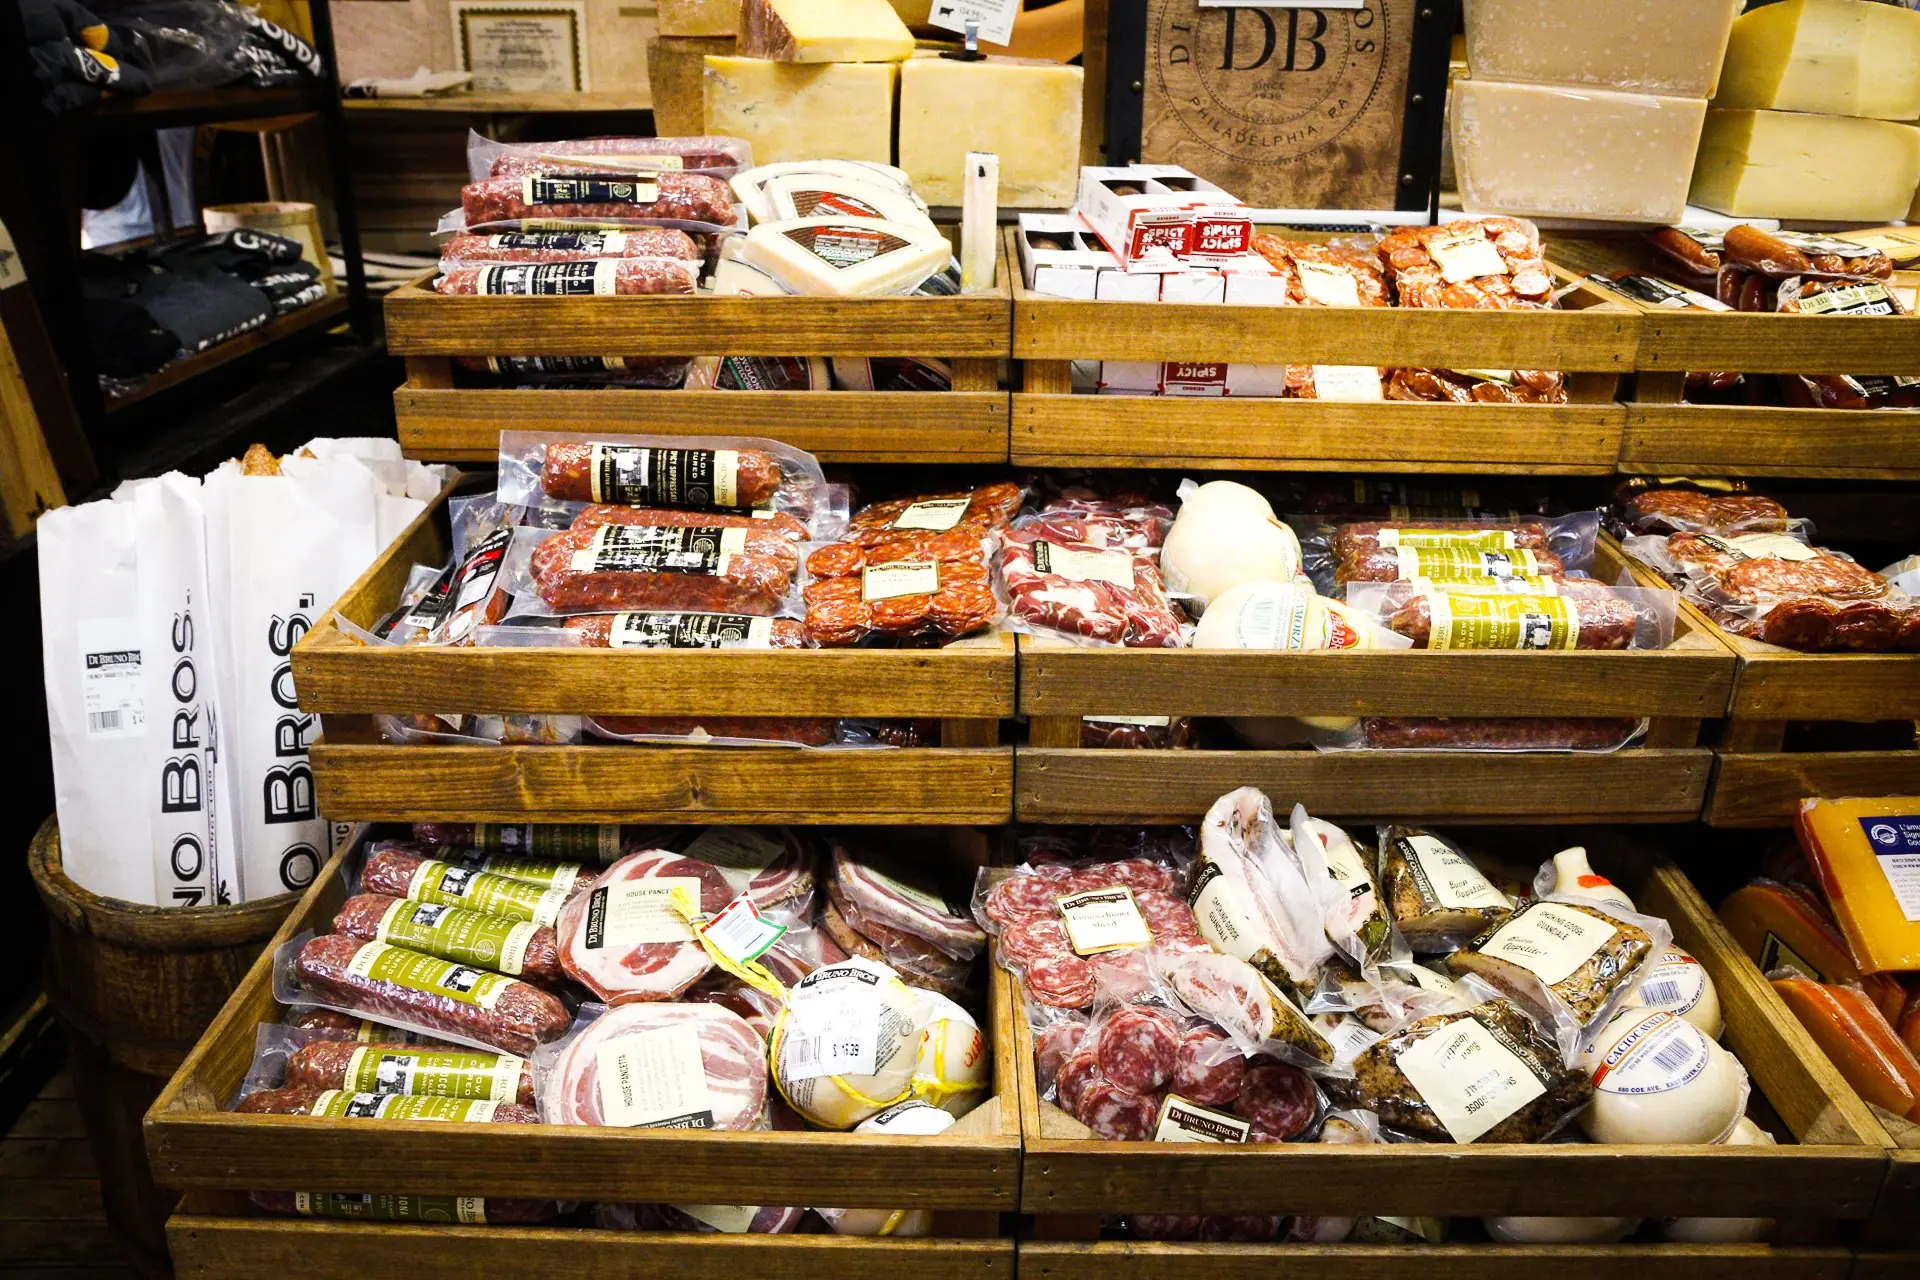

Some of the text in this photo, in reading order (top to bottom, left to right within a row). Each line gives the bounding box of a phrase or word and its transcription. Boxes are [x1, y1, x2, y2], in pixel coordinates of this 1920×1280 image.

[1169, 24, 1191, 66] DI
[1216, 7, 1328, 72] DB
[1189, 95, 1348, 147] PHILADELPHIA PA
[1202, 224, 1243, 236] SPICY
[1176, 366, 1217, 377] SPICY
[669, 466, 678, 503] SOPPRESSAT
[1409, 860, 1431, 892] BRUNO
[625, 888, 672, 898] HOUSE PANCE
[1425, 895, 1435, 904] DI
[1212, 896, 1229, 923] SMOKING
[589, 910, 600, 935] BRUNO
[1208, 911, 1228, 944] GUANCIALE
[1536, 920, 1570, 941] GUANCIALE
[1539, 911, 1586, 937] SMOKING GOOSE
[588, 935, 598, 944] DI
[1474, 936, 1487, 946] DI
[804, 975, 815, 984] DI
[814, 969, 850, 980] BRUNO
[1483, 1017, 1498, 1031] DI
[1496, 1027, 1530, 1058] BRUNO
[618, 1053, 634, 1108] HOUSE PANCETTA
[691, 1117, 706, 1129] DI
[1171, 1108, 1182, 1120] DI
[1182, 1114, 1215, 1131] BRUNO
